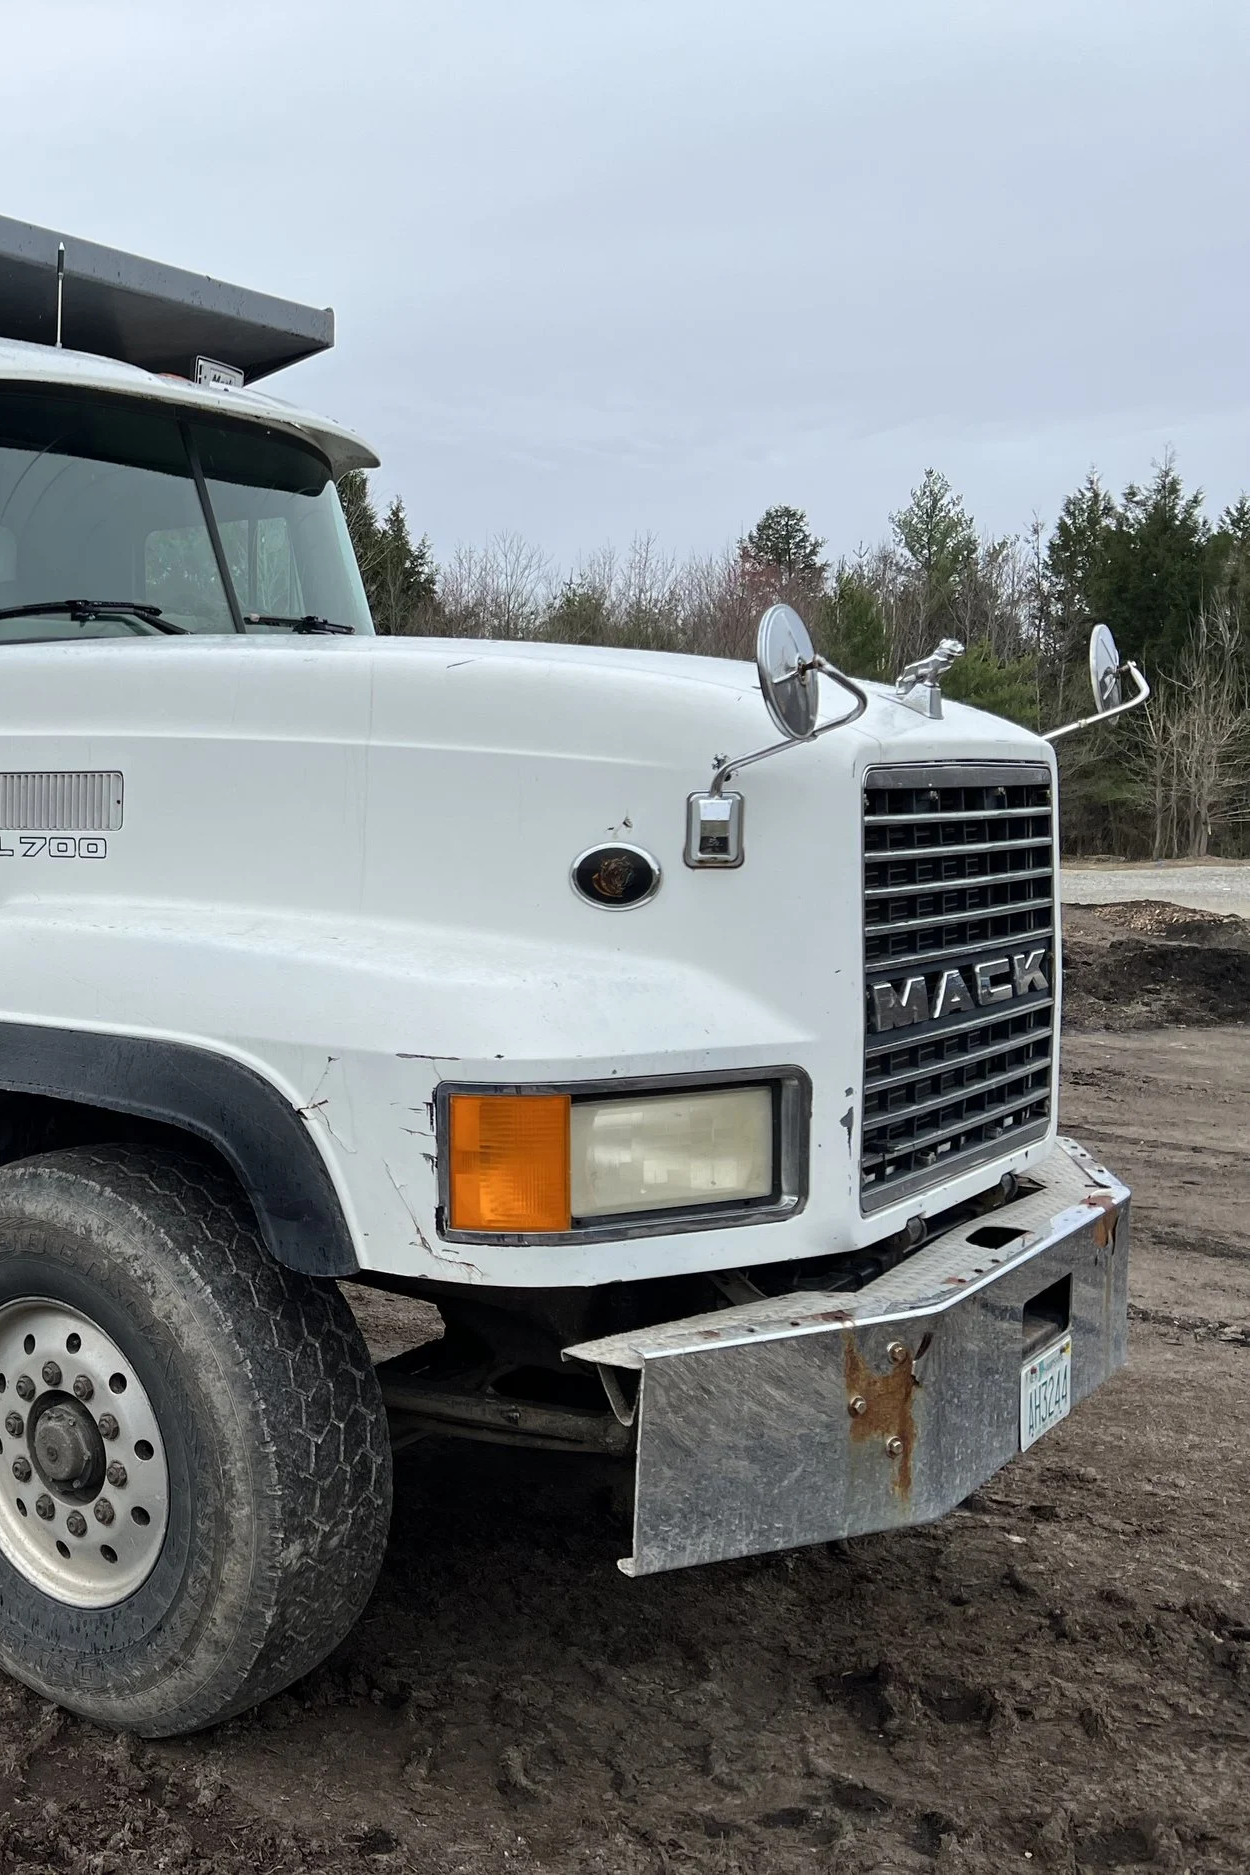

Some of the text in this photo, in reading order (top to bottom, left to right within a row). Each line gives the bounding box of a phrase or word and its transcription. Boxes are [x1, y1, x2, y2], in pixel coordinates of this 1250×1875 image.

[19, 836, 107, 858] 700
[869, 949, 1049, 1032] MACK
[1028, 1364, 1068, 1435] AH3244
